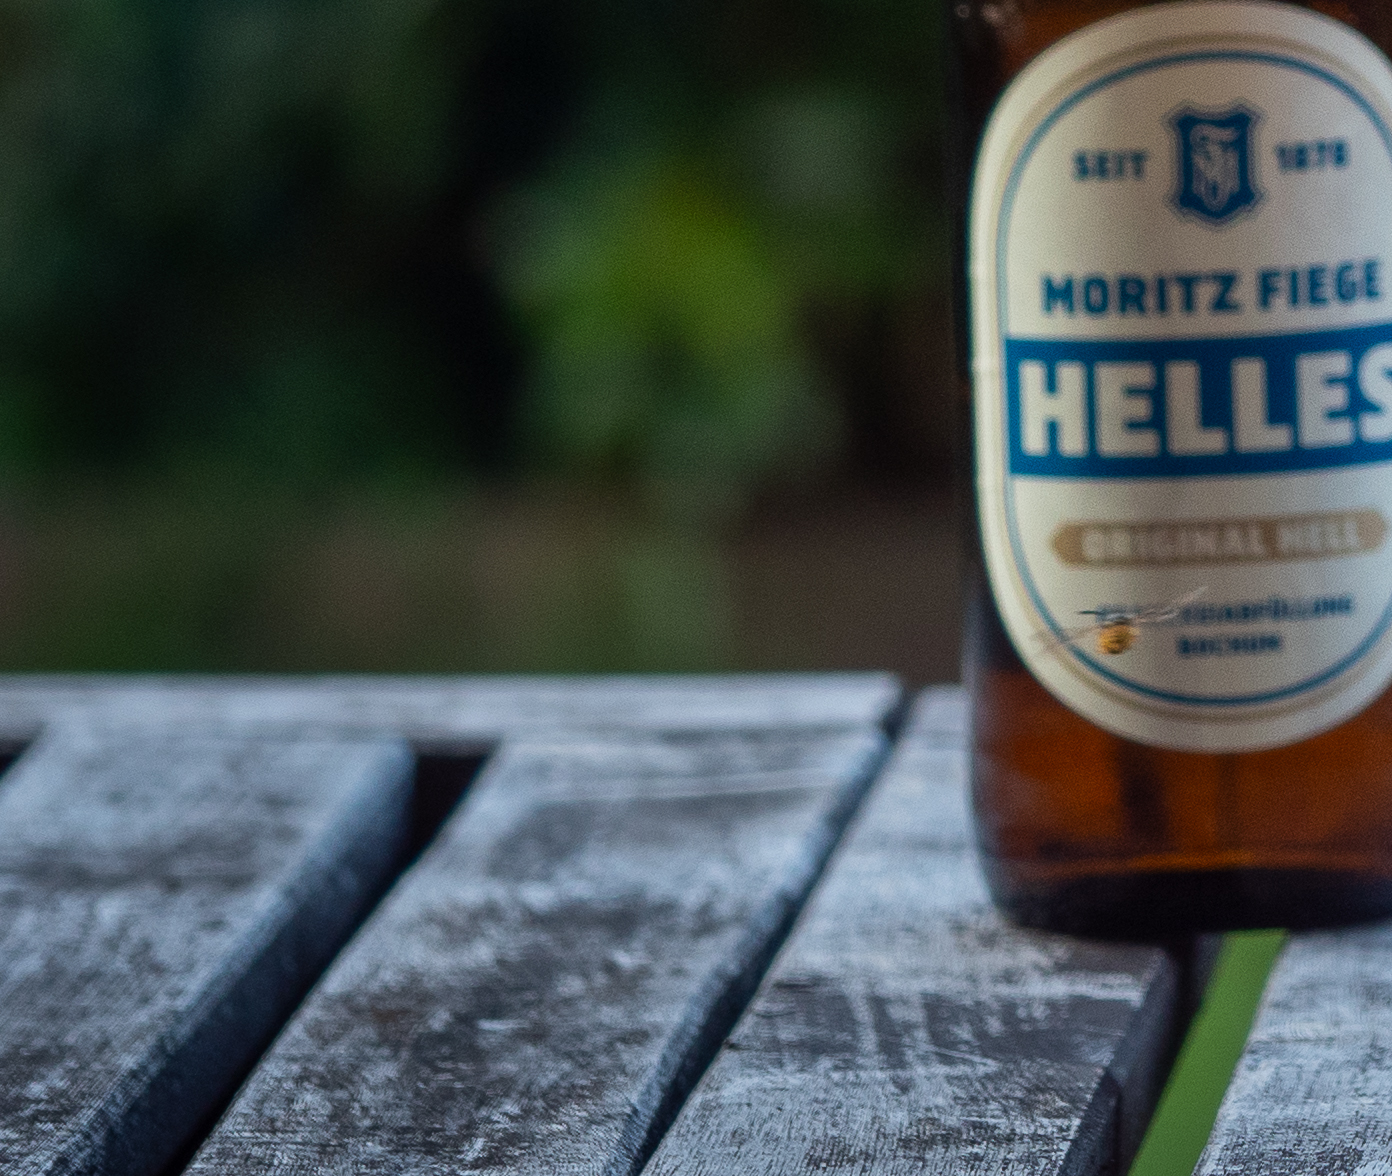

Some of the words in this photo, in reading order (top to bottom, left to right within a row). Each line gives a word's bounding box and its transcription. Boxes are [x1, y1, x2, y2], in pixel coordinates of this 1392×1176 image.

[1074, 148, 1147, 181] SEIT
[1042, 271, 1240, 316] MORITZ
[1258, 259, 1382, 310] FIEGE
[1081, 527, 1267, 565] ORIGINAL
[1276, 520, 1363, 557] HELL
